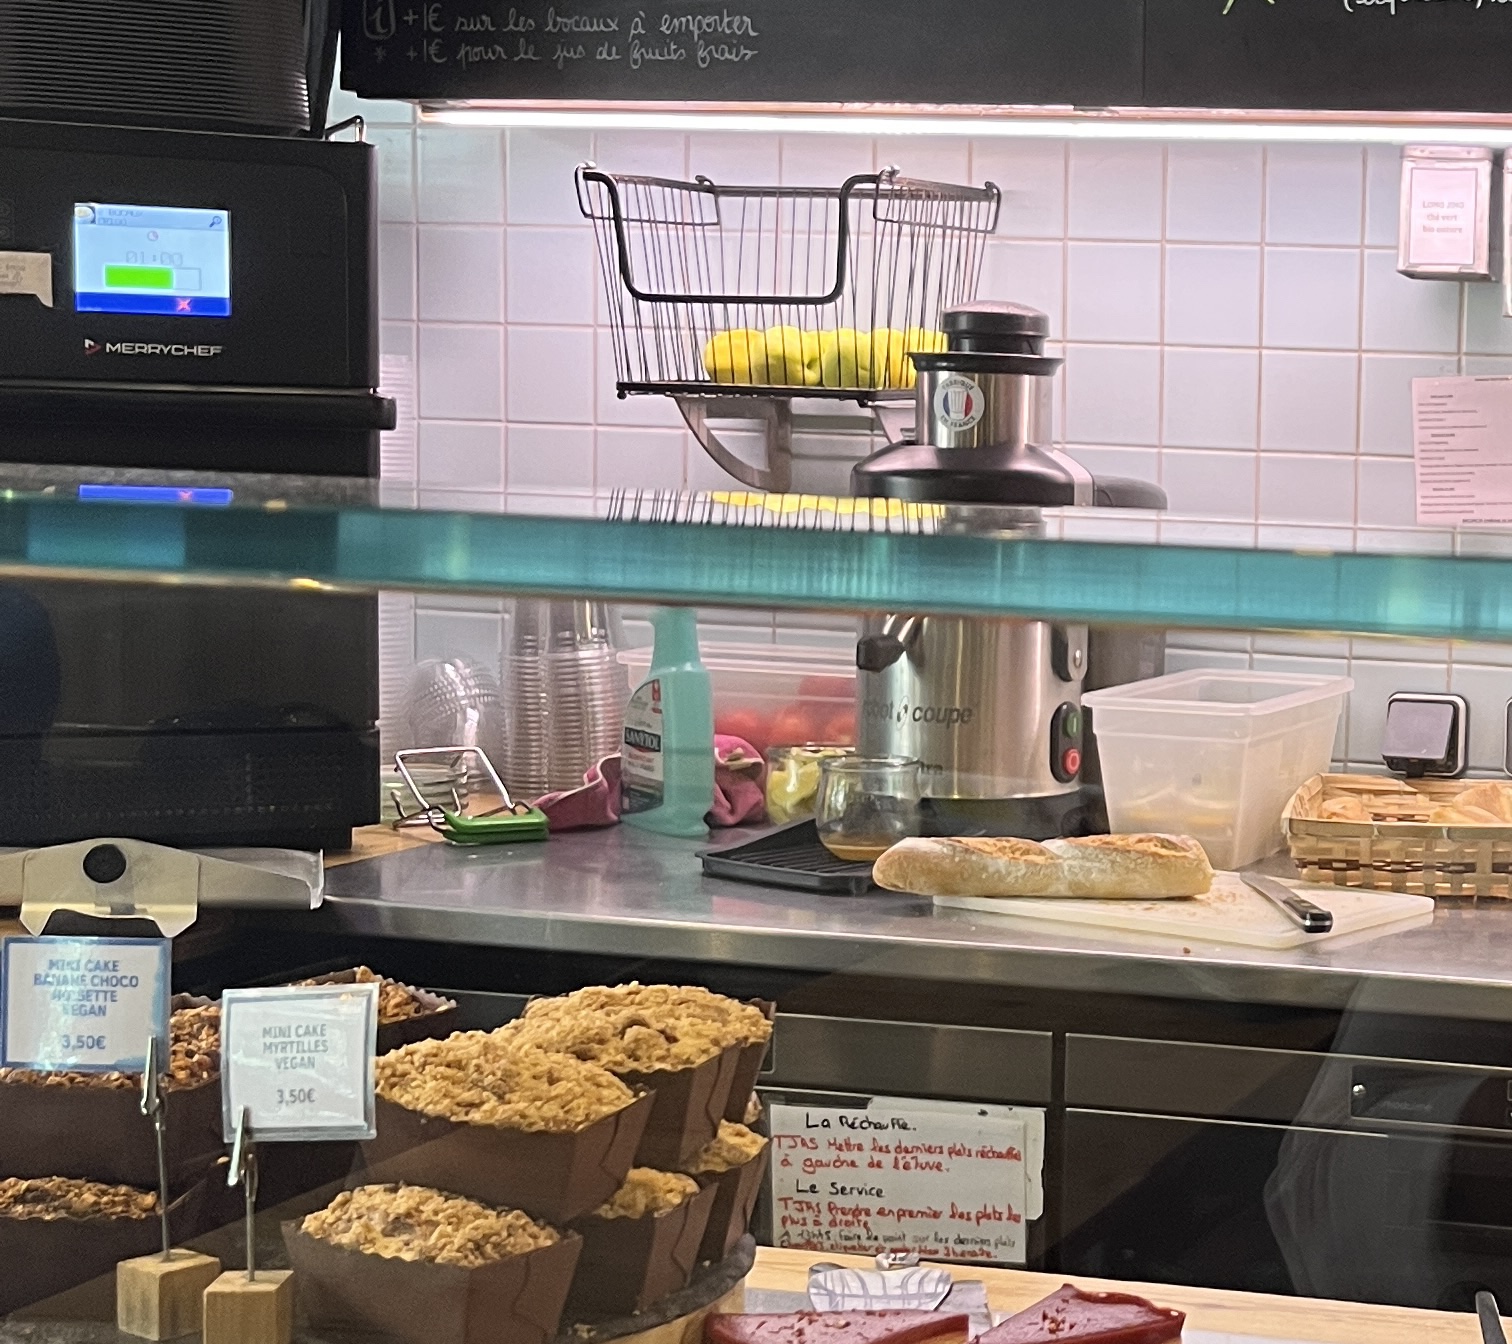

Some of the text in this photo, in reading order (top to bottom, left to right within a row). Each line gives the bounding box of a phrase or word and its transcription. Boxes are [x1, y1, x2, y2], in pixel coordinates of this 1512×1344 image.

[105, 342, 223, 357] MERRYCHEF
[912, 704, 973, 730] coupe
[85, 959, 120, 972] CAKE
[90, 974, 139, 988] CHOCO
[51, 989, 118, 1003] NOSETTE
[262, 1024, 327, 1039] MINI CAKE
[62, 1035, 107, 1051] 3,50€
[262, 1040, 329, 1055] MYRTILLES
[275, 1056, 315, 1070] VEGAN
[276, 1089, 316, 1105] 3,50€
[806, 1112, 831, 1129] La
[796, 1179, 885, 1198] Le Service
